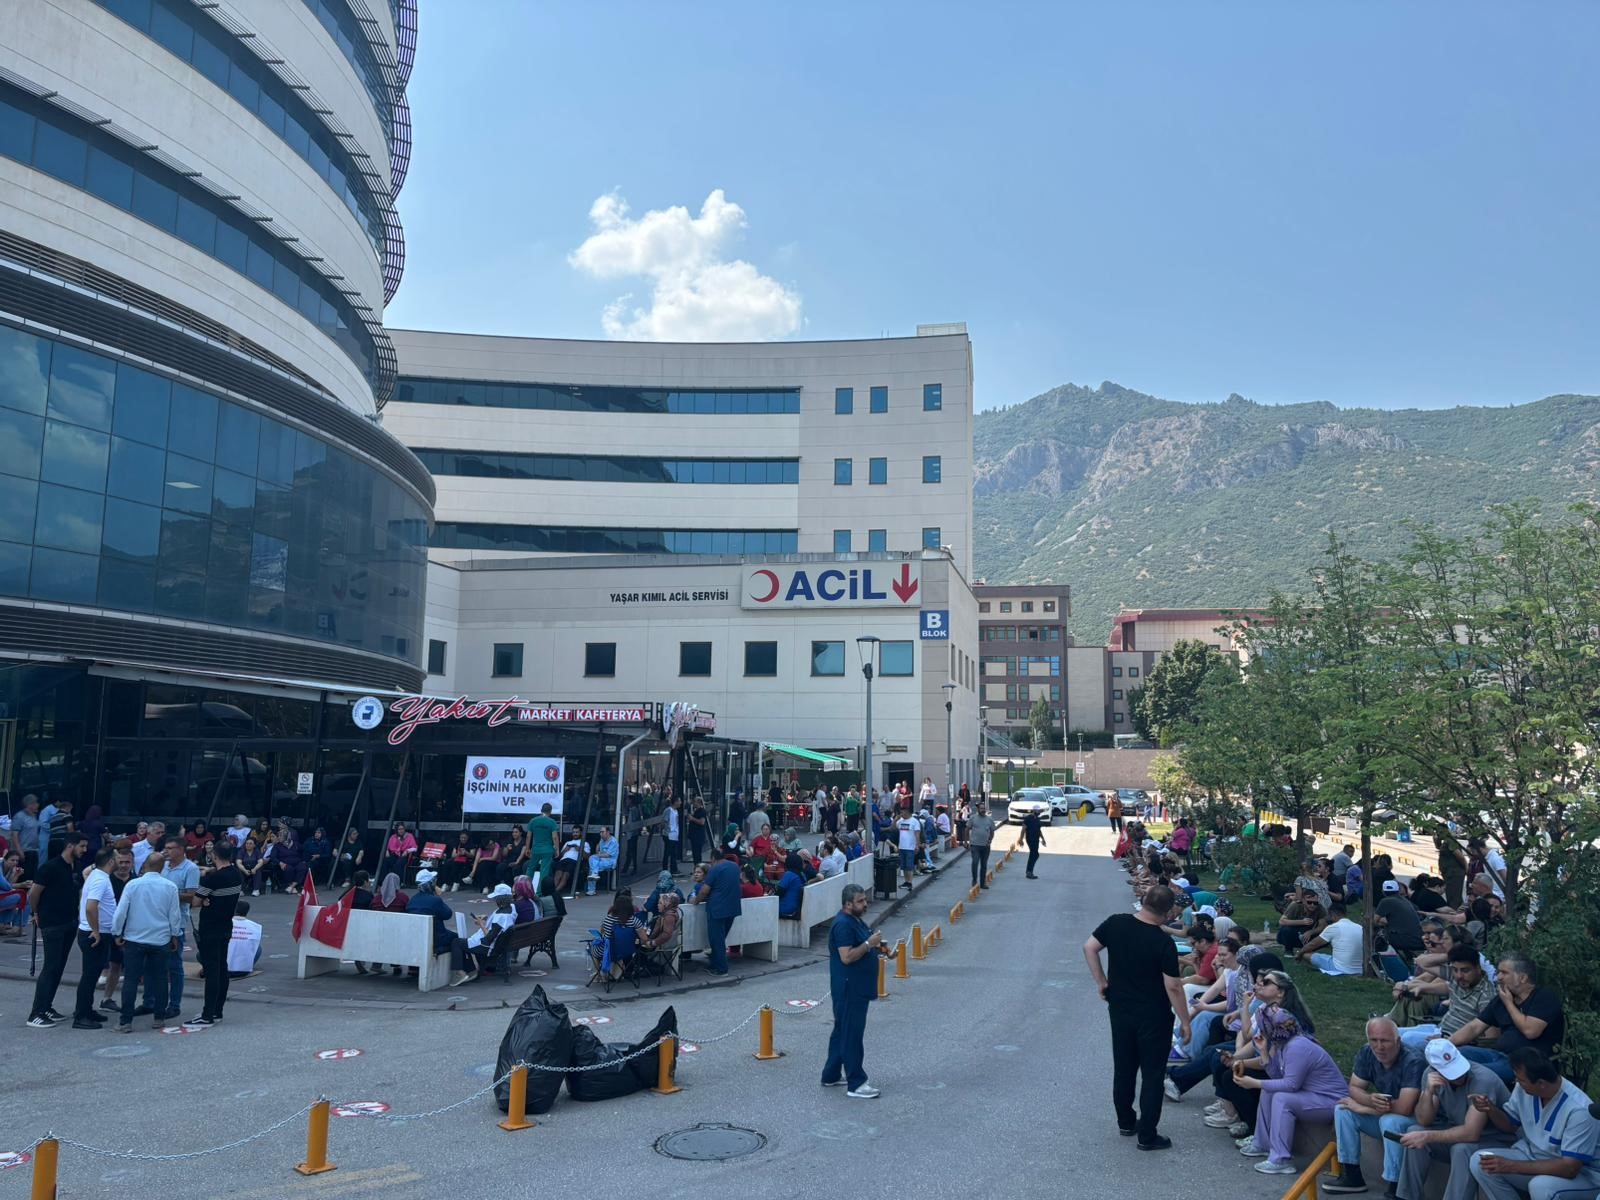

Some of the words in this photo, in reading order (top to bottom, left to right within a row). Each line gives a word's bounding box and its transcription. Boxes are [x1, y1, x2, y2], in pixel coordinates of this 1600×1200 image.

[610, 593, 639, 605] YAŞAR
[641, 592, 667, 602] KIMIL
[669, 590, 690, 602] ACİL
[692, 589, 729, 601] SERVİSİ
[927, 613, 942, 629] B
[387, 695, 529, 745] Yakut
[519, 709, 572, 720] MARKET
[576, 709, 643, 720] KAFETERYA
[504, 768, 527, 779] PAÜ
[467, 780, 510, 794] İŞÇİNİN
[513, 783, 562, 793] HAKKINI
[502, 796, 526, 806] VER
